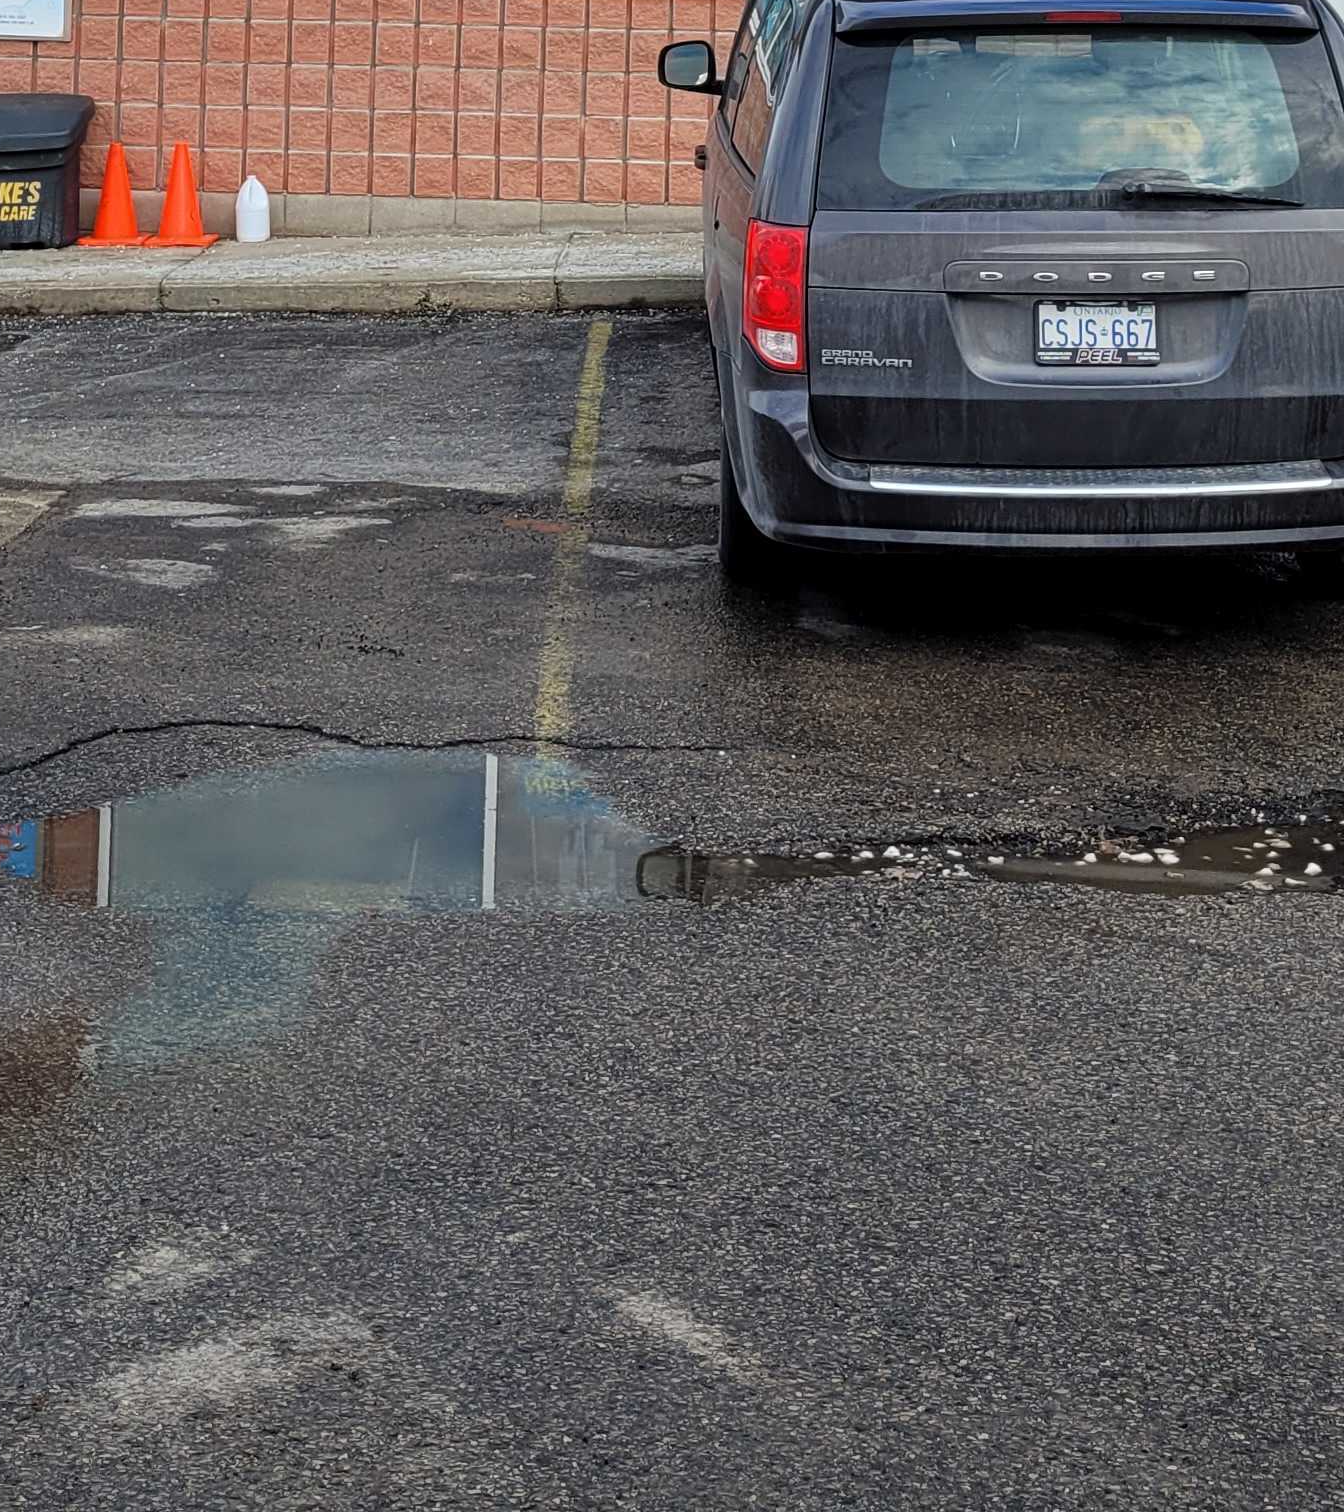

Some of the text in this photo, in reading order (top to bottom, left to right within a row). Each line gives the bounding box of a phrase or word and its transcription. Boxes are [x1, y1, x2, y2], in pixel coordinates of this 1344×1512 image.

[0, 206, 37, 221] CARE
[979, 270, 1216, 282] DODGE
[1073, 307, 1122, 316] ONTARIO
[821, 349, 873, 357] GRAND
[1076, 349, 1123, 363] PEEL
[821, 356, 913, 368] CARAVAN
